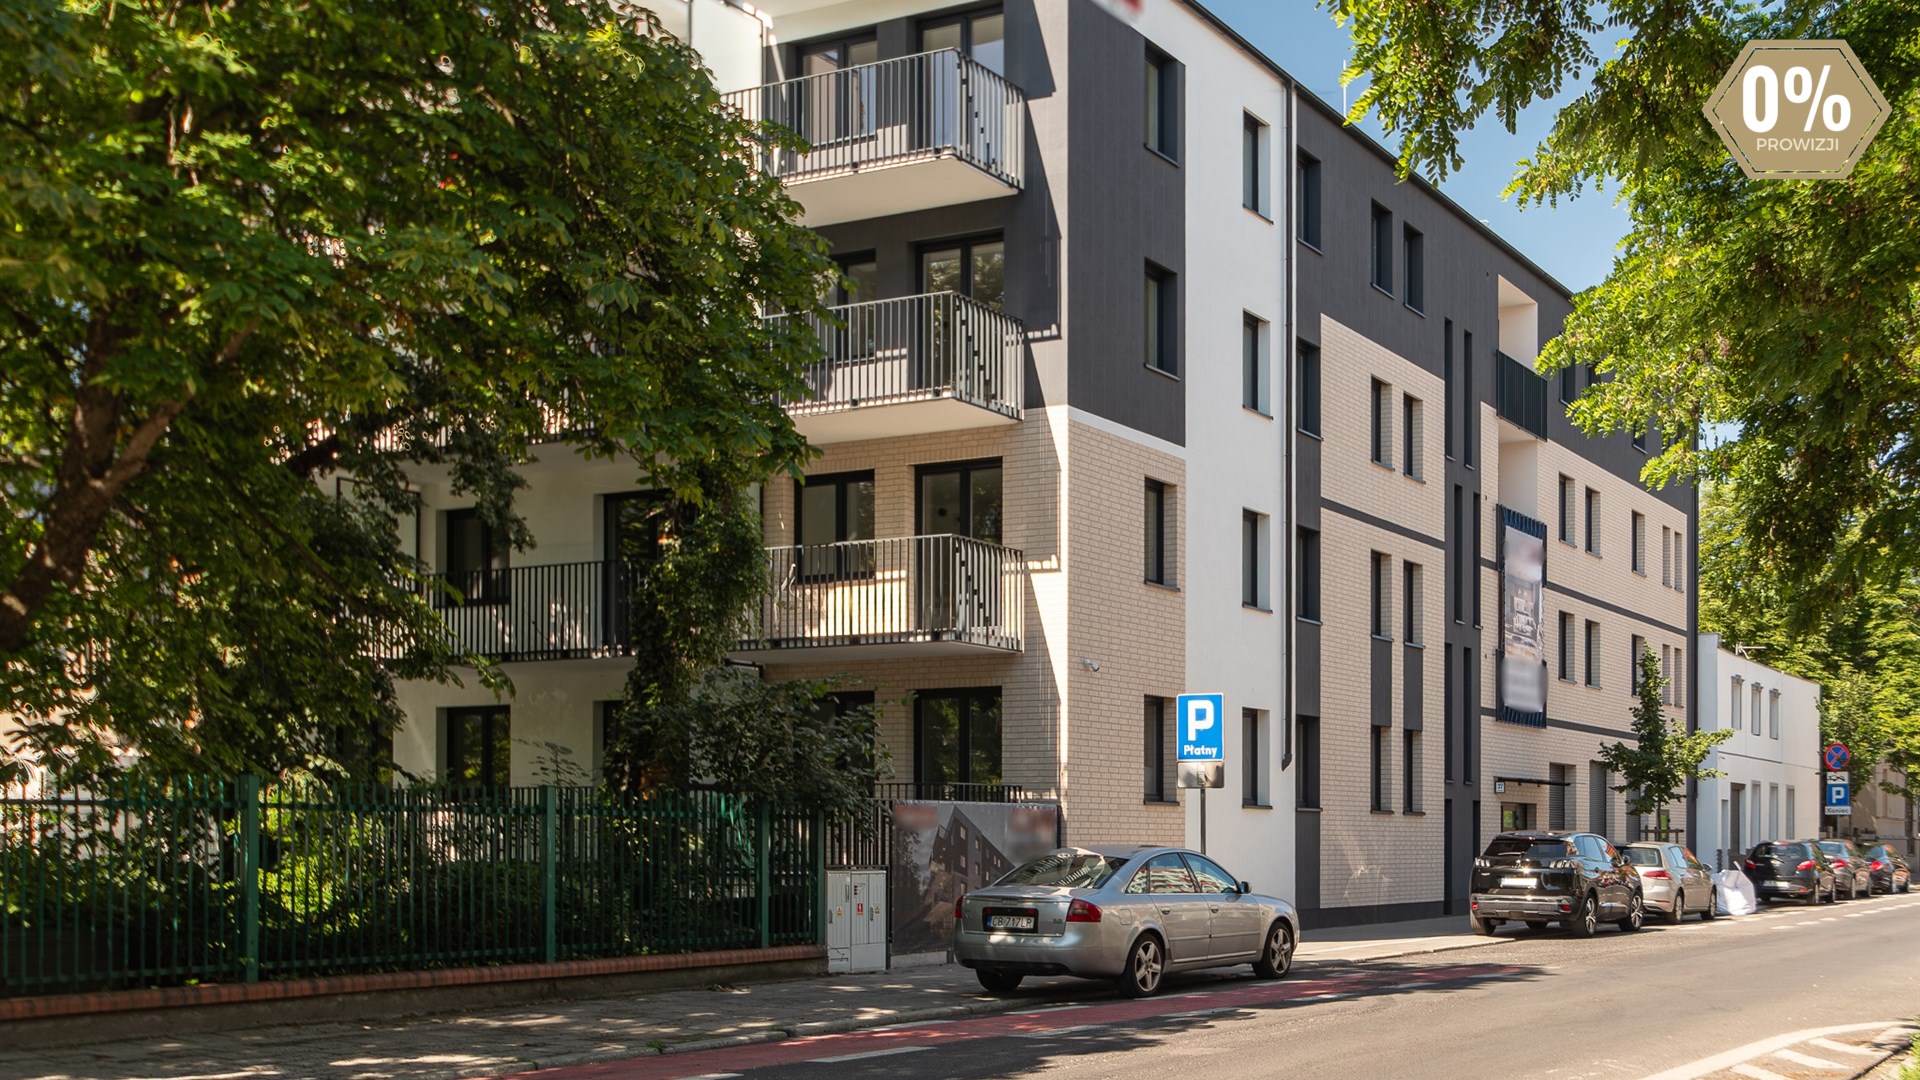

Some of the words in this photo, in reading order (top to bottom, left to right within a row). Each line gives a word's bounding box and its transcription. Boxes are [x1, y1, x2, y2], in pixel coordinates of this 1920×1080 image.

[1187, 699, 1215, 741] P
[1183, 744, 1218, 758] Płatny
[1831, 786, 1845, 804] P
[992, 916, 1004, 927] CB
